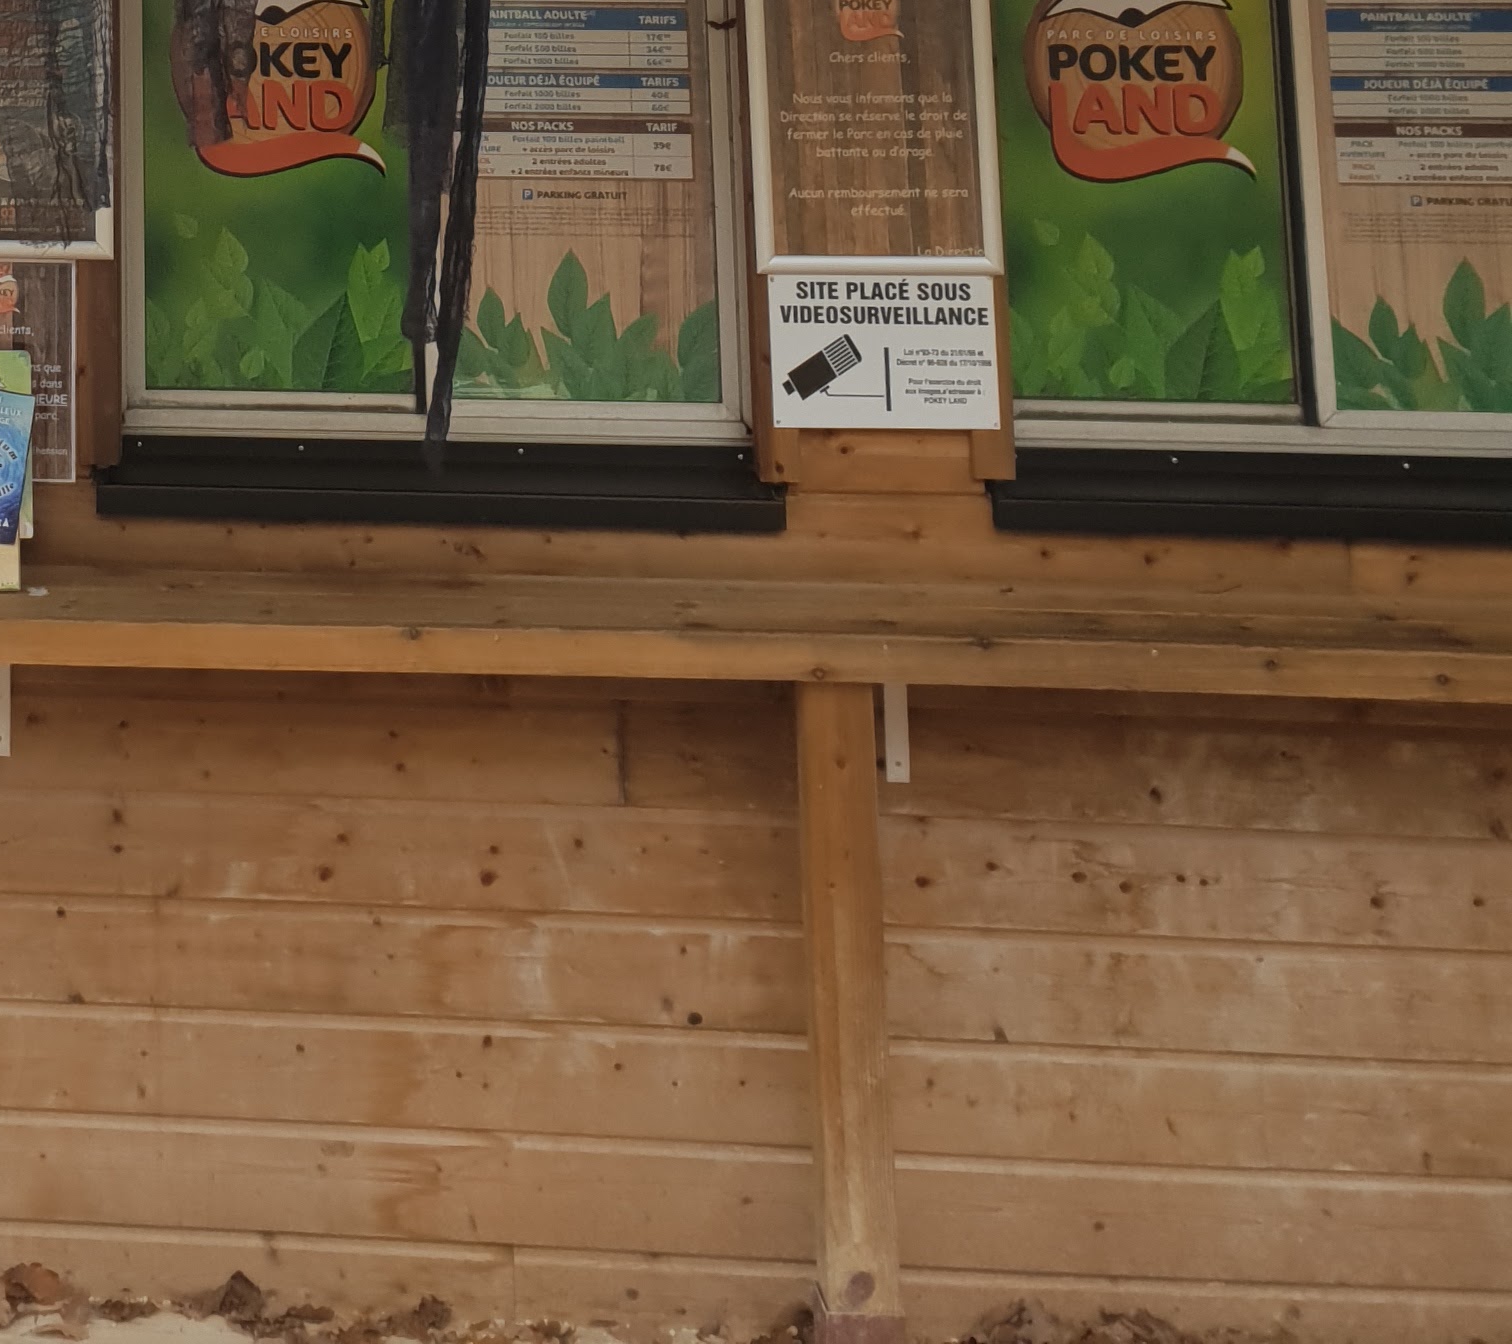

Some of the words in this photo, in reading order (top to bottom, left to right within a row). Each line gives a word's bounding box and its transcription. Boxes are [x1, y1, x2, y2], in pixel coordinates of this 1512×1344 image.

[490, 11, 541, 19] AINTBALL
[544, 11, 587, 20] ADULTE
[639, 16, 676, 24] TARIFS
[1360, 12, 1423, 22] PAINTBALL
[280, 27, 353, 39] LOISIRS
[1047, 30, 1094, 40] PARC
[1106, 30, 1128, 40] DE
[1140, 30, 1217, 41] LOISIRS
[829, 52, 864, 63] Chers
[867, 52, 911, 64] clients,
[1048, 44, 1216, 82] POKEY
[488, 76, 527, 86] OUEUR
[529, 75, 556, 85] DÉJÀ
[559, 75, 600, 86] ÉQUIPÉ
[641, 77, 679, 86] TARIFS
[1364, 80, 1410, 89] JOUEUR
[1413, 78, 1443, 89] DÉJÀ
[1445, 78, 1488, 90] ÉQUIPÉ
[793, 93, 822, 104] Nous
[826, 95, 852, 104] vous
[856, 92, 914, 103] informons
[918, 95, 938, 105] que
[943, 92, 952, 102] la
[1048, 83, 1223, 136] LAND
[780, 112, 835, 122] Direction
[856, 111, 901, 122] réserve
[906, 111, 915, 121] le
[919, 111, 949, 121] droit
[953, 111, 968, 120] de
[511, 122, 535, 130] NOS
[537, 122, 574, 131] PACKS
[646, 122, 677, 131] TARIF
[1396, 127, 1421, 135] NOS
[1424, 127, 1463, 136] PACKS
[787, 129, 828, 140] fermer
[833, 129, 843, 139] le
[847, 128, 873, 139] Parc
[877, 131, 891, 139] en
[894, 130, 913, 138] cas
[917, 128, 931, 138] de
[935, 128, 963, 141] pluie
[816, 147, 869, 157] battante
[873, 148, 886, 157] ou
[538, 191, 582, 199] PARKING
[585, 191, 627, 200] GRATUIT
[789, 188, 824, 198] Aucun
[828, 187, 920, 198] remboursement
[925, 189, 937, 197] ne
[942, 189, 968, 198] sera
[1427, 197, 1473, 206] PARKING
[796, 281, 838, 300] SITE
[846, 279, 910, 301] PLACÉ
[917, 282, 971, 301] SOUS
[780, 305, 989, 326] VIDEOSURVEILLANCE
[43, 364, 61, 376] que
[40, 380, 62, 388] dans
[3, 517, 9, 527] À
